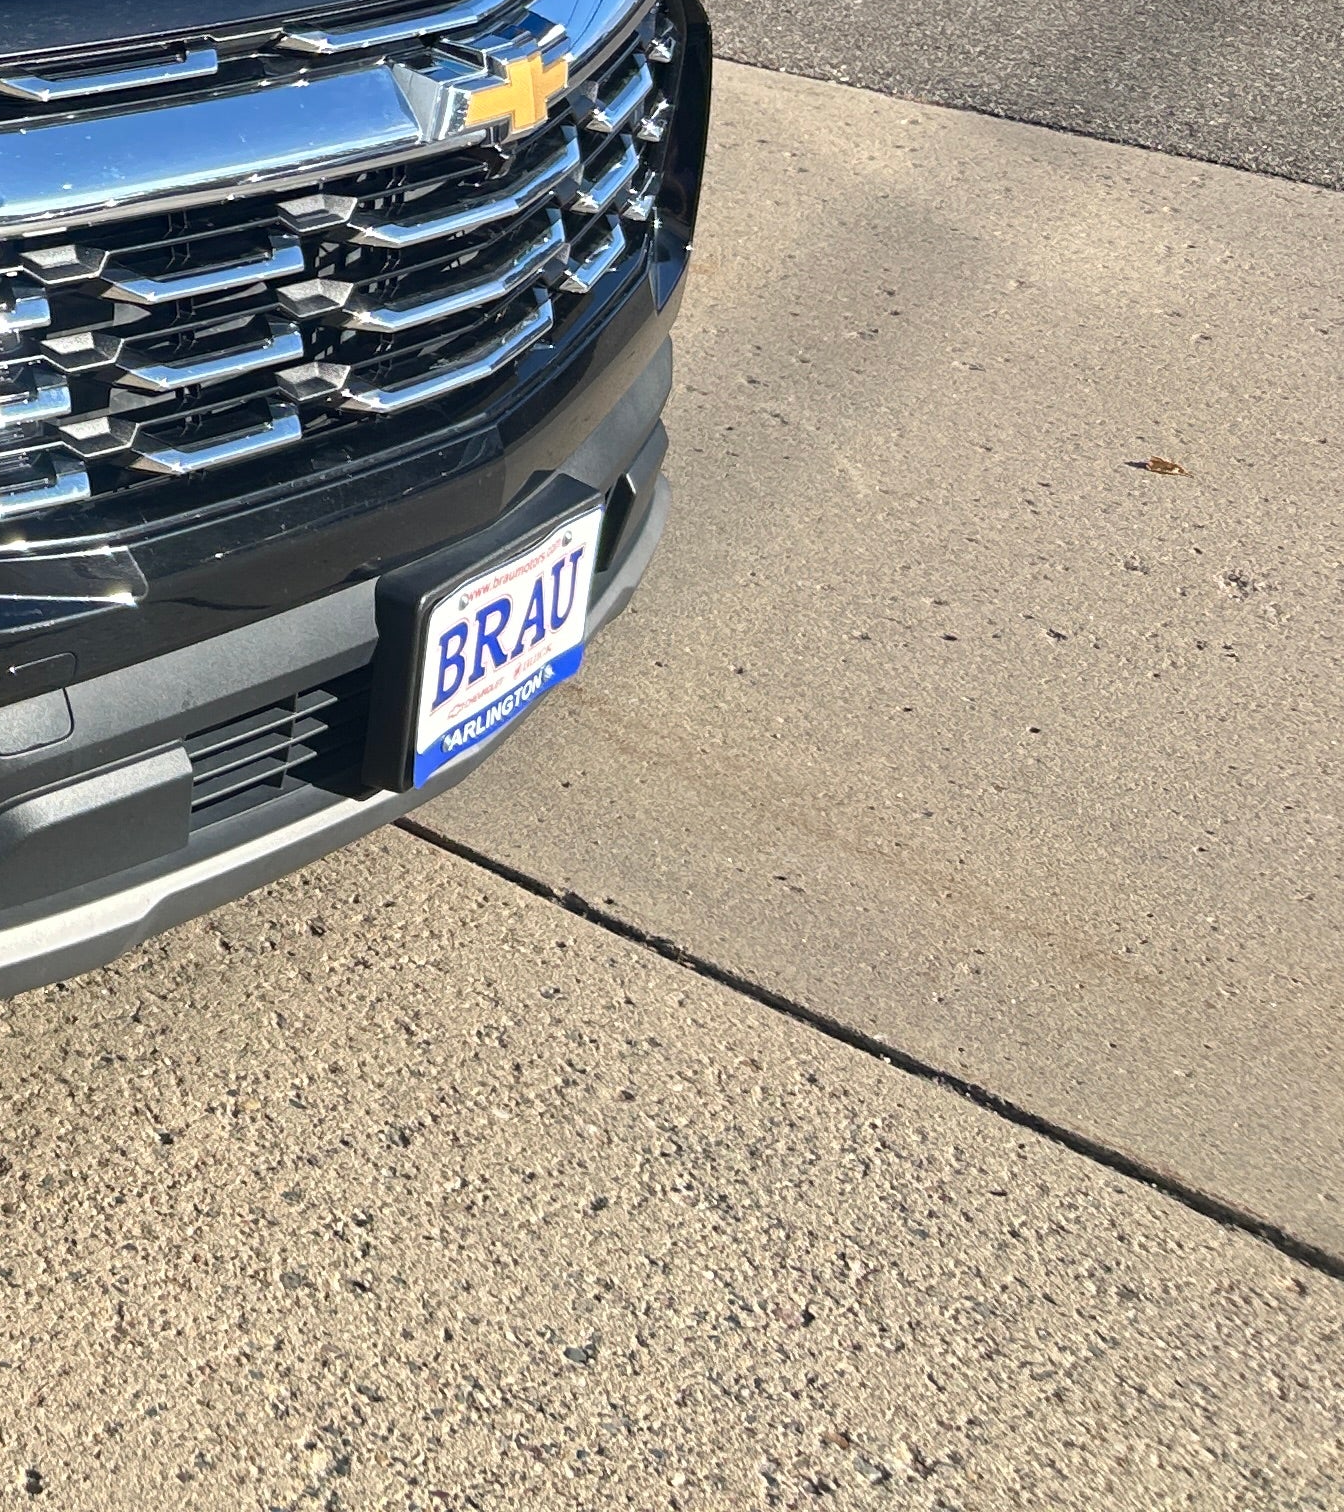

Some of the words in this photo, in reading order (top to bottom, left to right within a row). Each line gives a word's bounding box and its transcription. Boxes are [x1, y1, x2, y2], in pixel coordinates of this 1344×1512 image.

[468, 538, 562, 602] www.braumotors.com
[431, 549, 584, 710] BRAU
[447, 669, 543, 752] ARLINGTON
